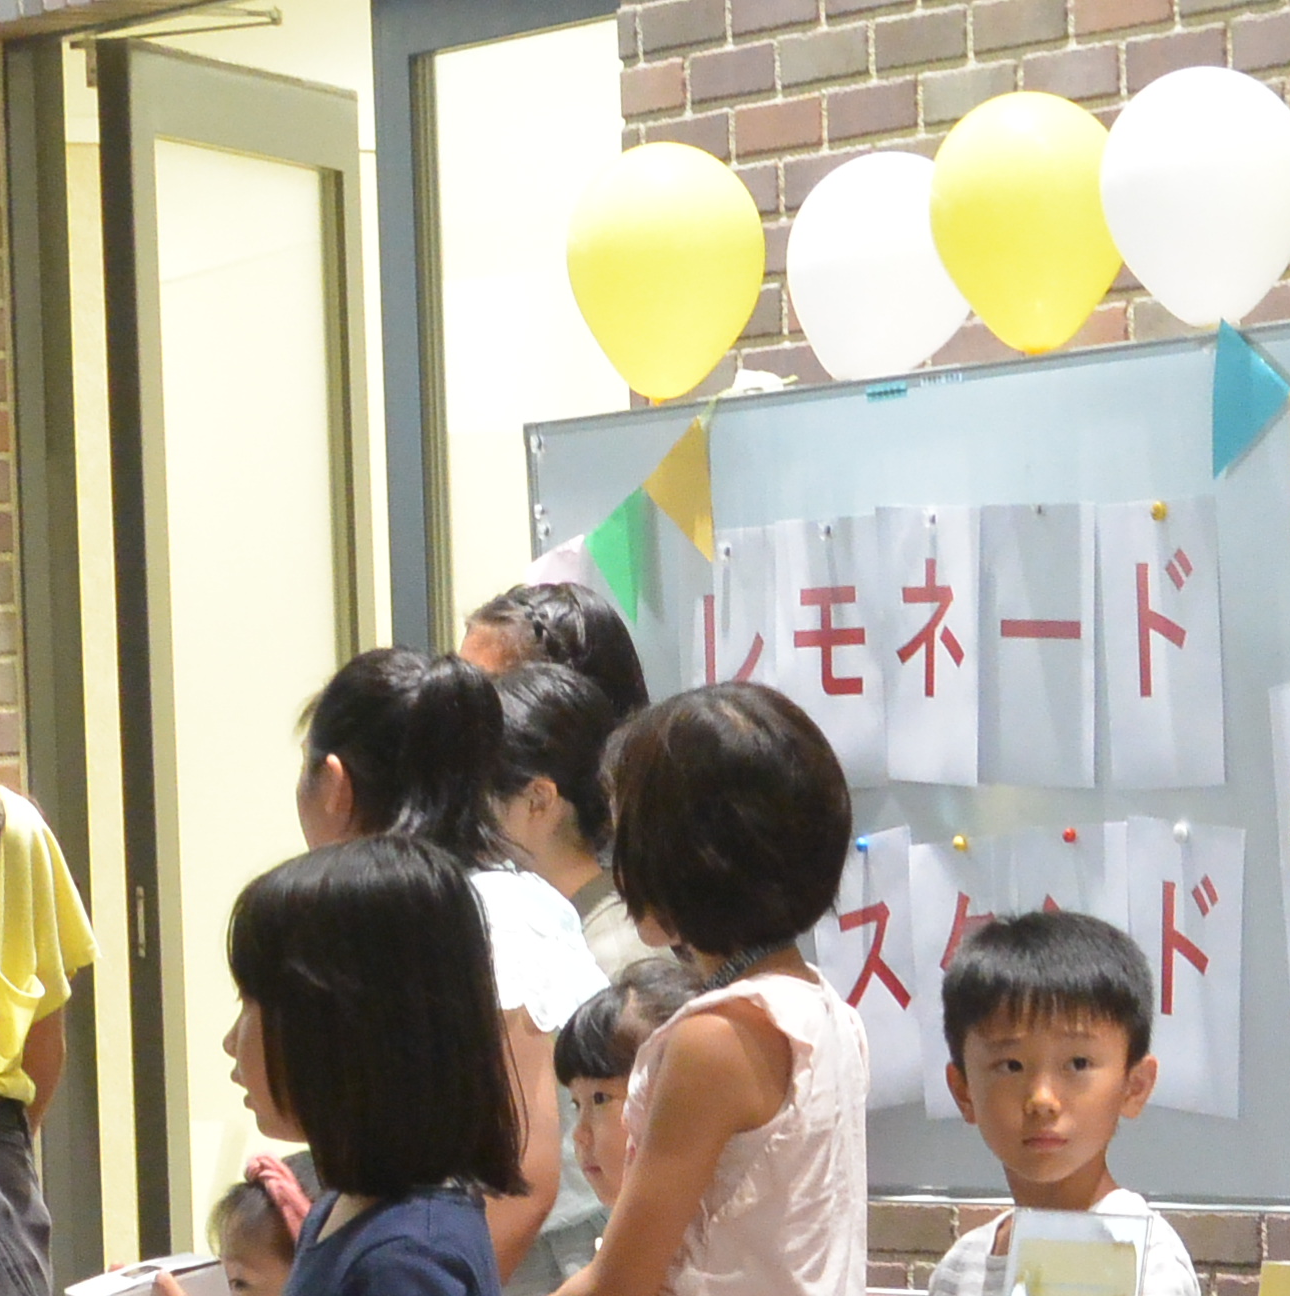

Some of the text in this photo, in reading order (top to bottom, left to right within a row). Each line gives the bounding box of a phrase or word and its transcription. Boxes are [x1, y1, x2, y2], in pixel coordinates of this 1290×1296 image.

[703, 548, 1194, 697] レモネード
